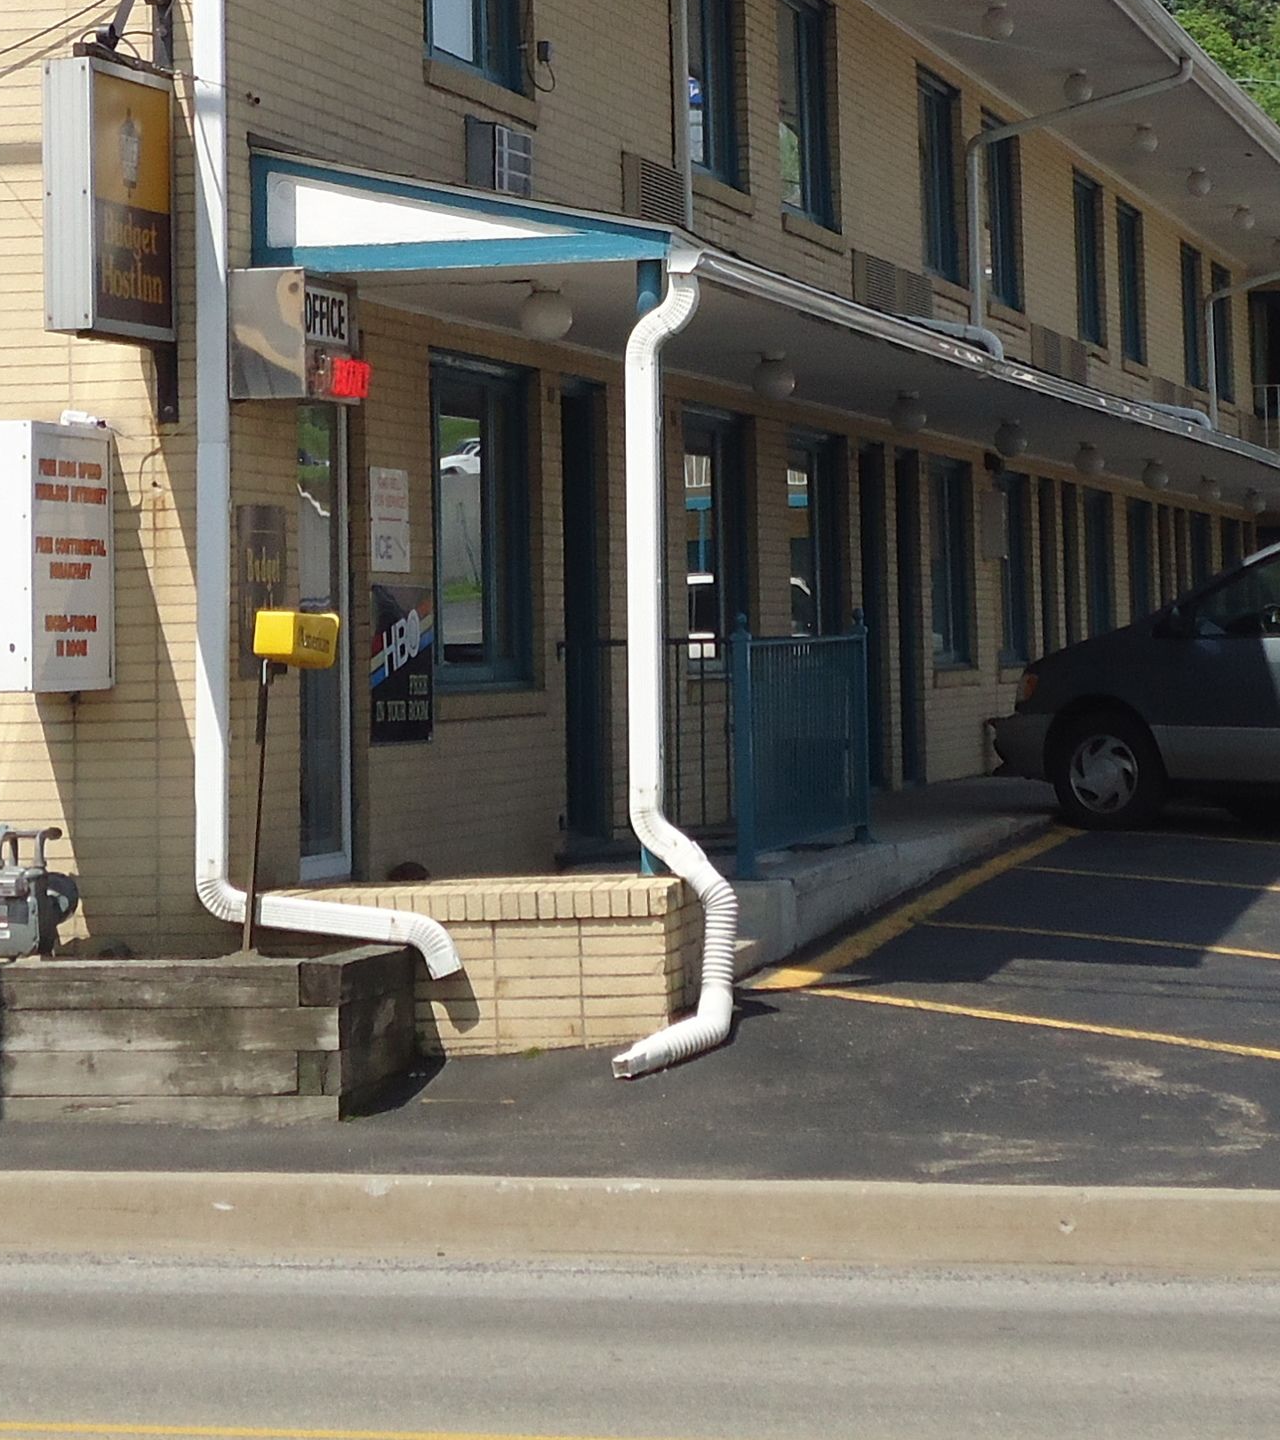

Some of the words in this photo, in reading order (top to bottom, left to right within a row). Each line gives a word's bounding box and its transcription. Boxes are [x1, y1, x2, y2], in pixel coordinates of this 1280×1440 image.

[104, 207, 157, 260] Budget
[102, 252, 135, 299] Host
[136, 261, 163, 304] Inn
[305, 292, 345, 339] OFFICE
[382, 608, 420, 678] HBO
